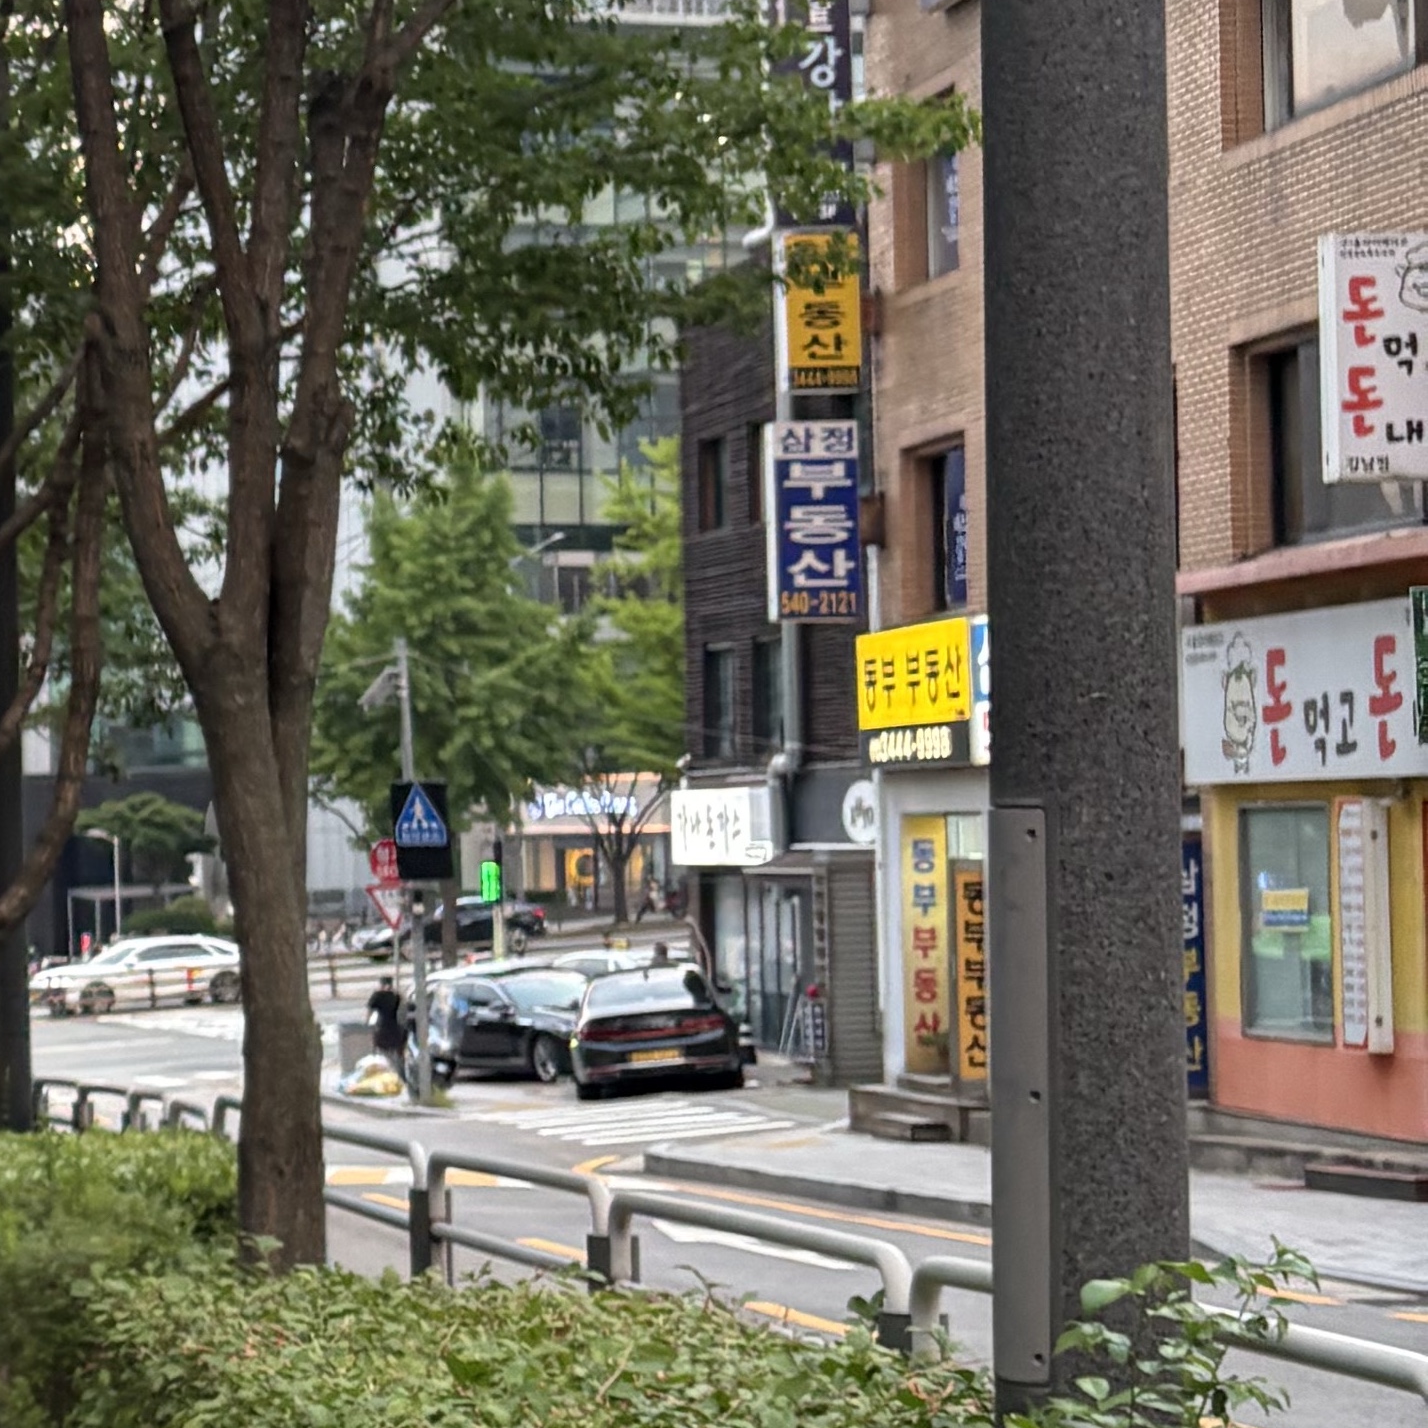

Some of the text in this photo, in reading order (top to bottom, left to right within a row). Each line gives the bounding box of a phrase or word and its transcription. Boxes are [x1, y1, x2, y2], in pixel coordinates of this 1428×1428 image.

[1342, 275, 1385, 348] 돈
[1341, 366, 1384, 439] 돈
[783, 461, 856, 587] 부동산
[781, 591, 856, 614] 540-2121
[864, 655, 896, 712] 동부
[905, 644, 962, 707] 부동산
[1262, 648, 1292, 767] 돈
[1303, 690, 1358, 767] 먹고
[1369, 635, 1403, 762] 돈
